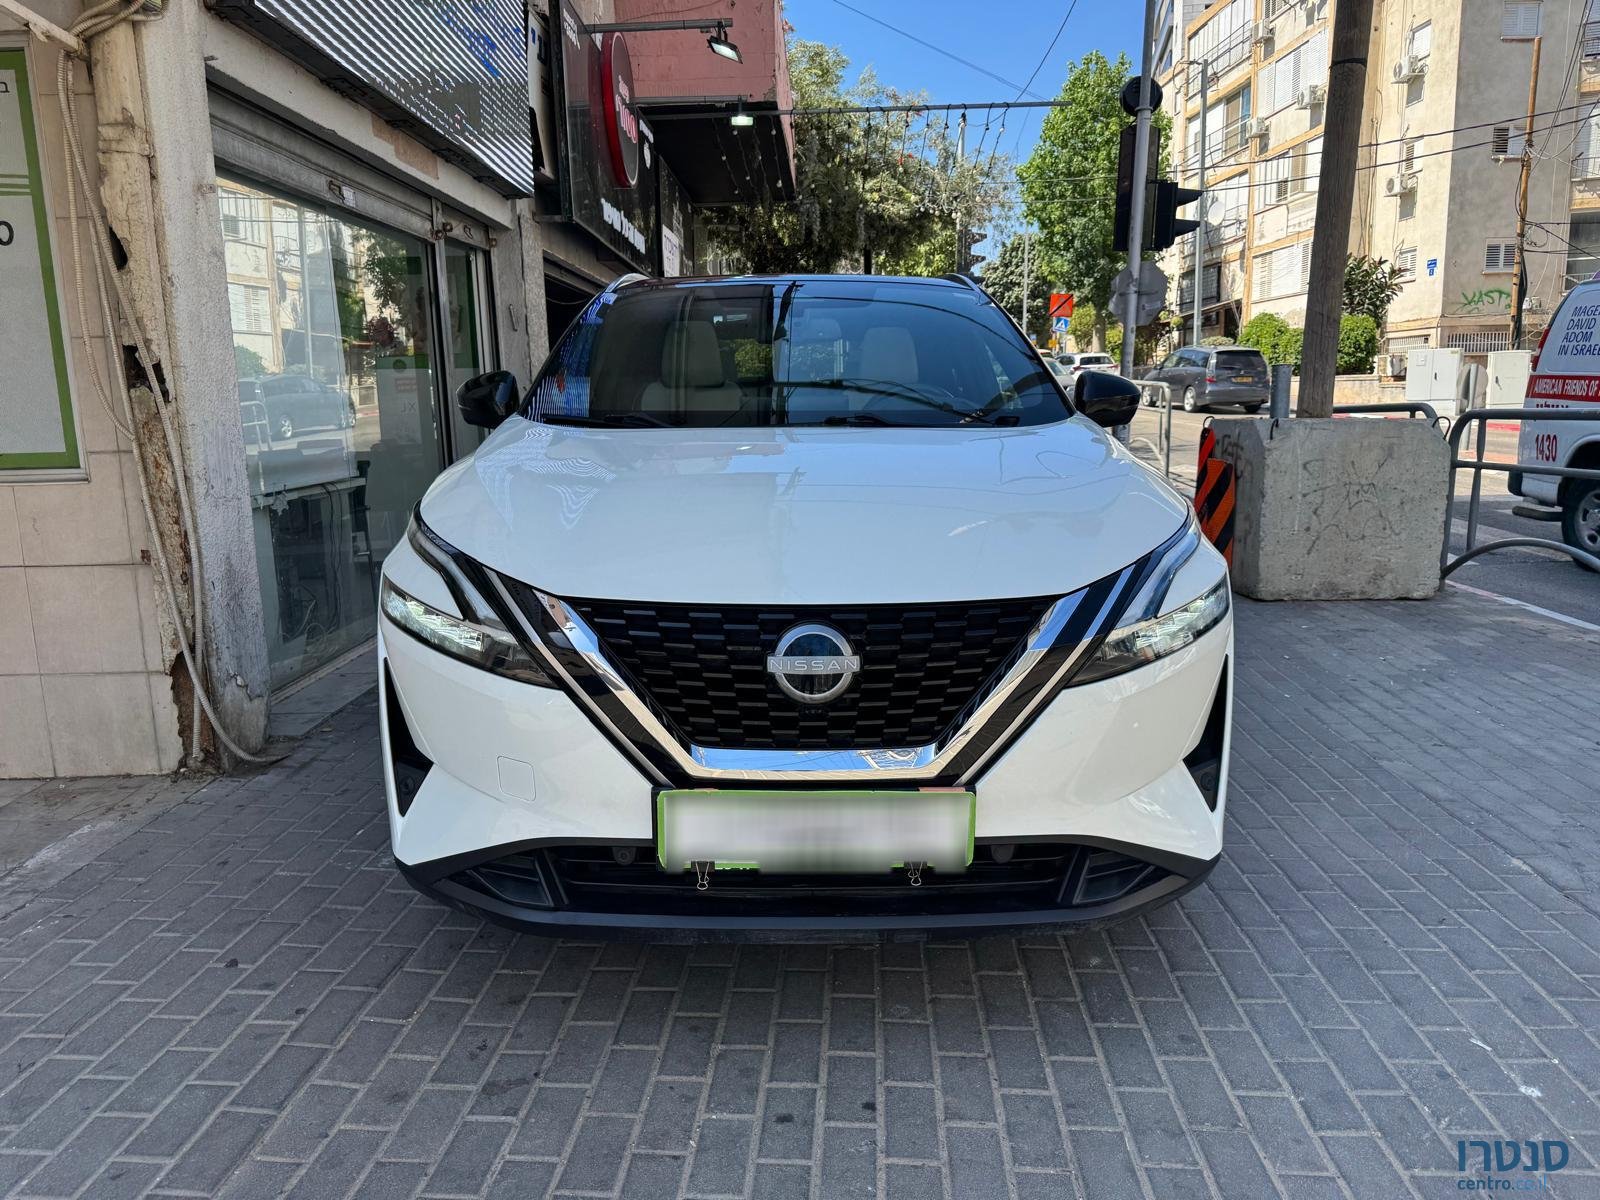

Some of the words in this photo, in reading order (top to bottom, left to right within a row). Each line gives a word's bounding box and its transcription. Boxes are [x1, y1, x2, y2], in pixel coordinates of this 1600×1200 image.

[1571, 305, 1600, 317] MAGE
[1566, 317, 1597, 331] DAVID
[1561, 331, 1593, 343] ADOM
[1557, 344, 1569, 356] IN
[1570, 343, 1600, 356] ISRAE
[1533, 378, 1564, 394] AMERICAN
[1563, 379, 1588, 396] FRIENDS
[1588, 380, 1599, 397] OF
[1535, 434, 1558, 462] 1430
[770, 659, 857, 671] NISSAN
